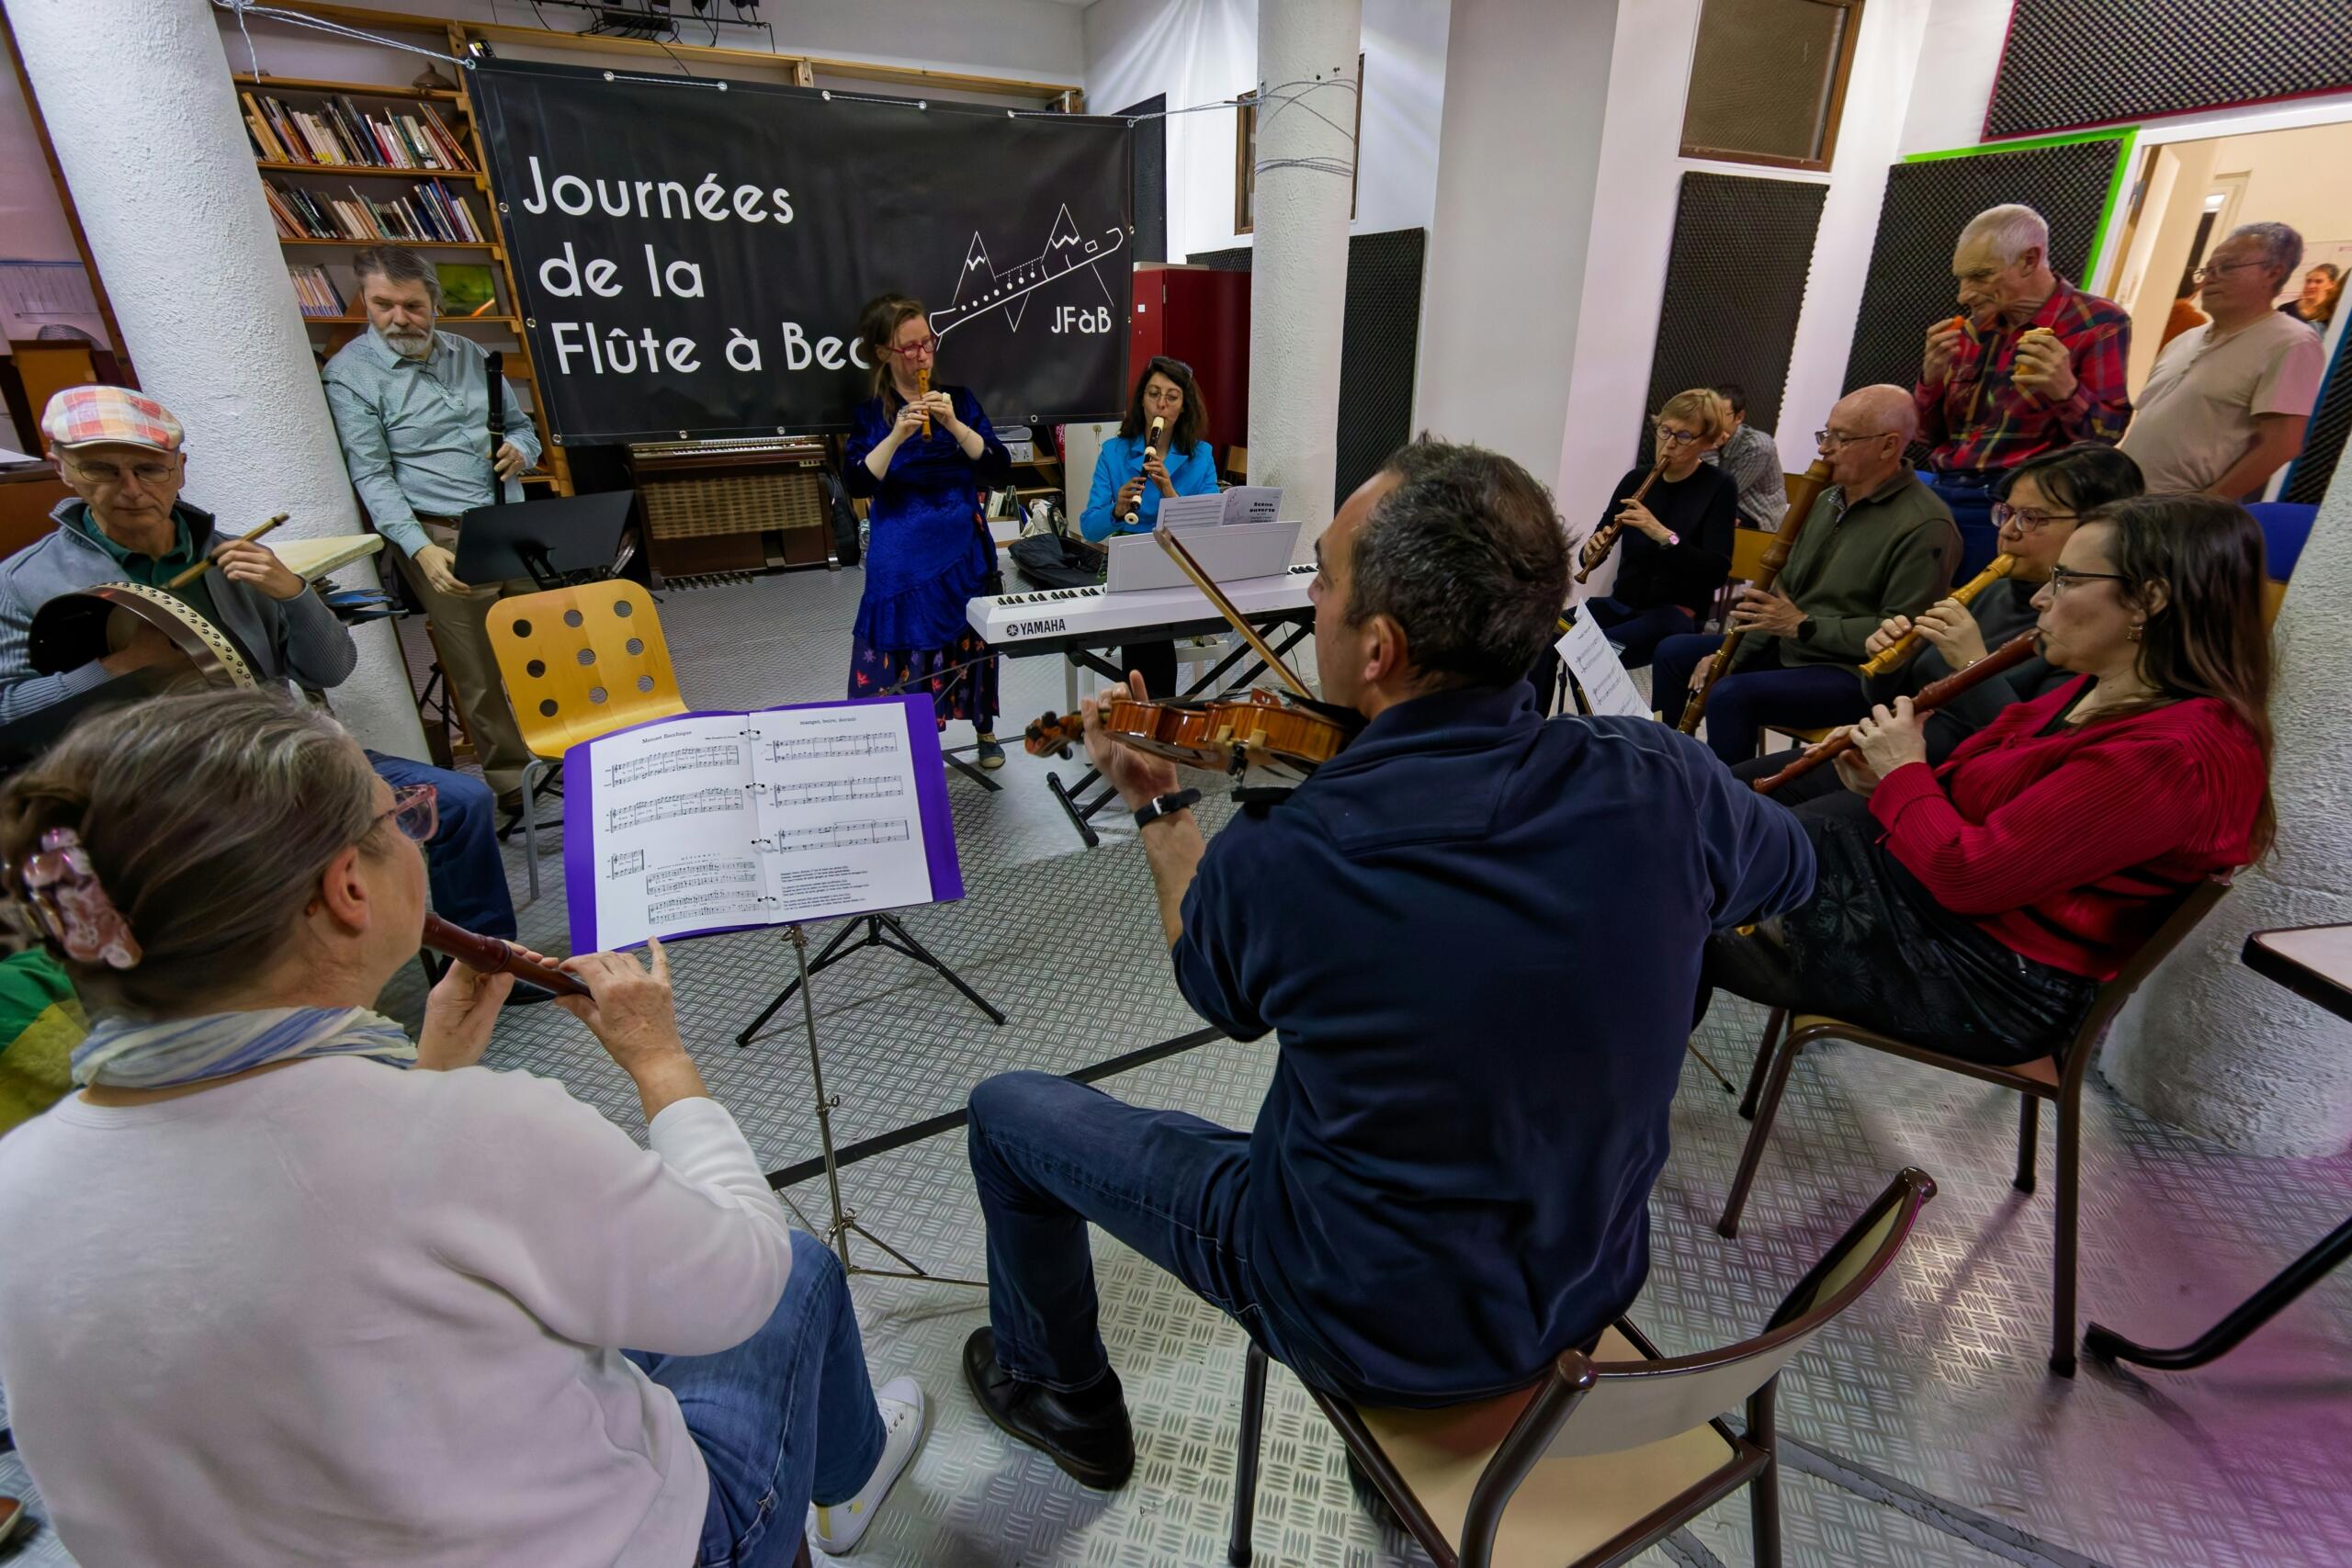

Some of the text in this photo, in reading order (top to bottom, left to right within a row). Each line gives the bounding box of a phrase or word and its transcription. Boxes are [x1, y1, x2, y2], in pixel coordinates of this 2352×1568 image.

[523, 156, 794, 224] Journées
[539, 242, 705, 298] de la
[1050, 306, 1112, 333] JFàB
[551, 321, 701, 375] Flûte
[725, 327, 763, 372] à
[1020, 618, 1066, 635] YAMAHA
